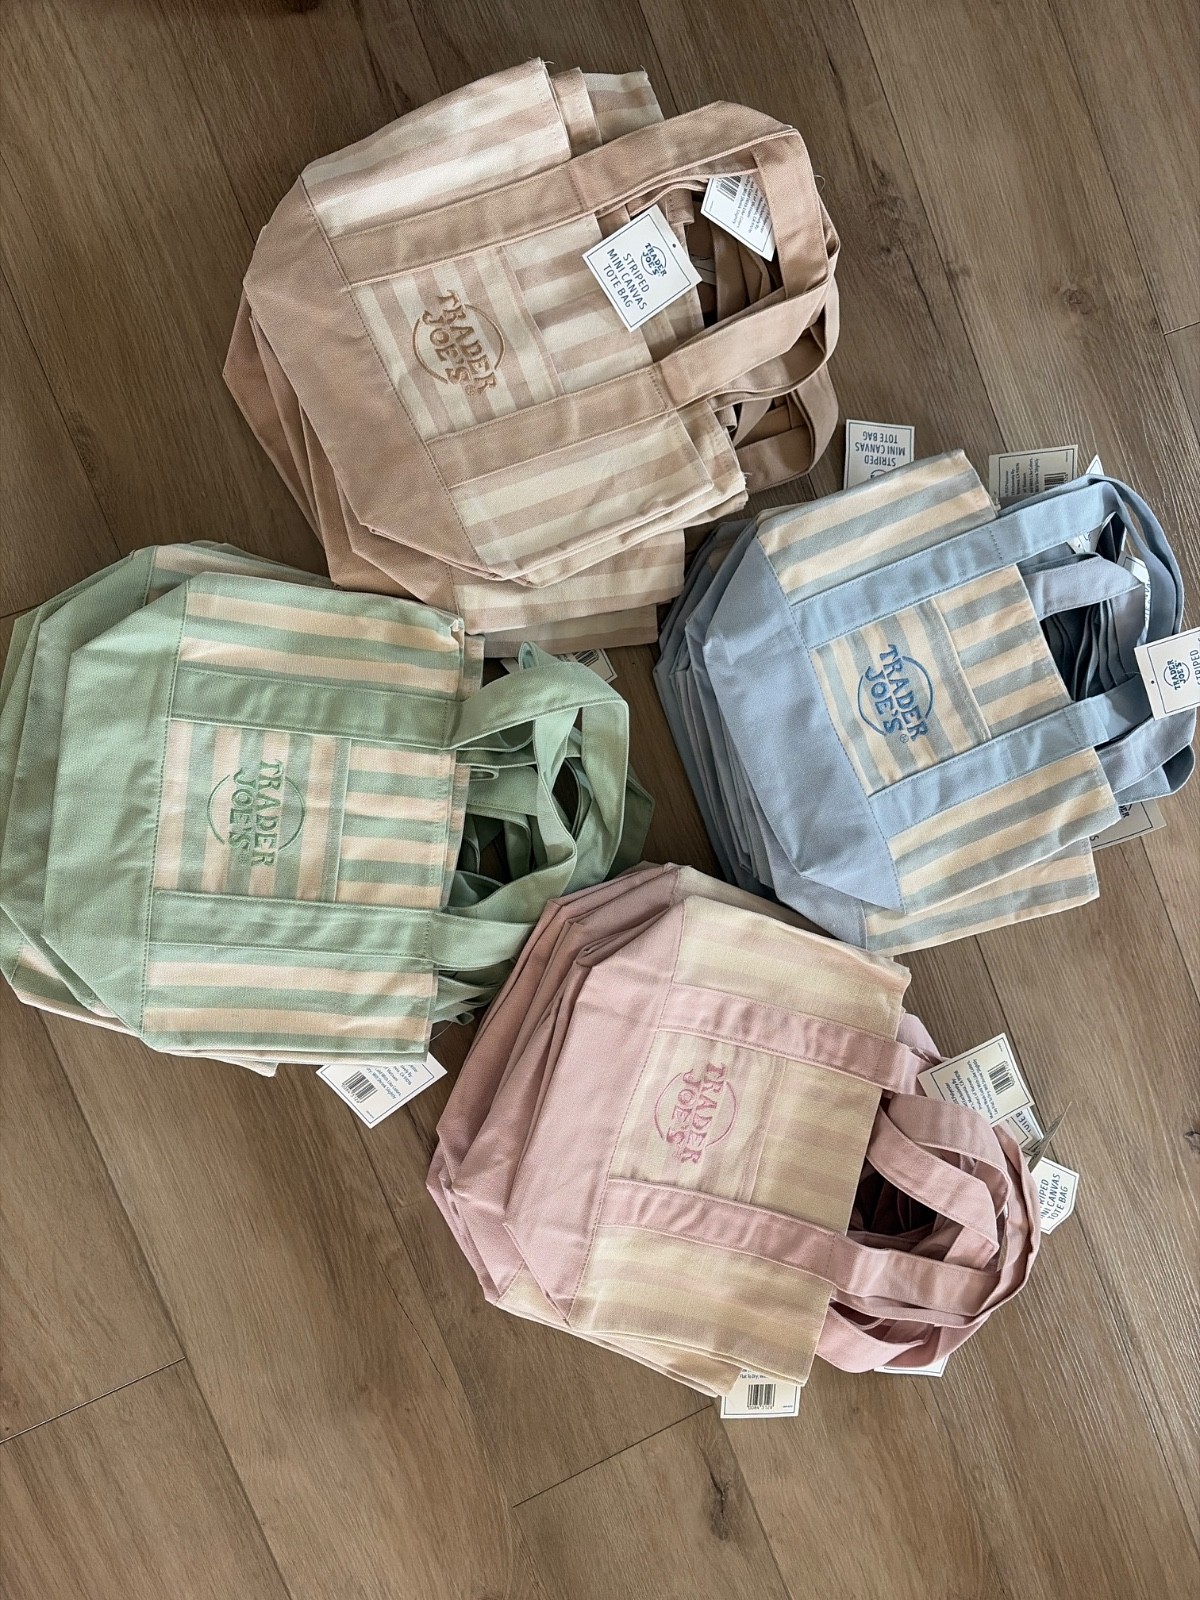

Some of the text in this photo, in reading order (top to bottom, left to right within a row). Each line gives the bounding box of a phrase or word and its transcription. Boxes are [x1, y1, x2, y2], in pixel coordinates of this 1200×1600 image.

[622, 252, 650, 293] STRIPED
[642, 250, 659, 275] JOE'S
[644, 242, 667, 276] TRADER
[603, 263, 633, 308] TOTE BAG
[606, 248, 647, 310] MINI CANVAS
[437, 289, 497, 394] TRADER
[854, 441, 905, 455] MINI CANVAS
[862, 430, 897, 443] TOTE BAG
[864, 455, 895, 466] STRIPED
[1167, 659, 1181, 691] TRADER
[880, 644, 929, 742] TRADER
[251, 759, 284, 866] TRADER
[681, 1062, 727, 1163] TRADER
[1046, 1174, 1060, 1206] CANVAS
[1047, 1185, 1068, 1219] TOTE BAG
